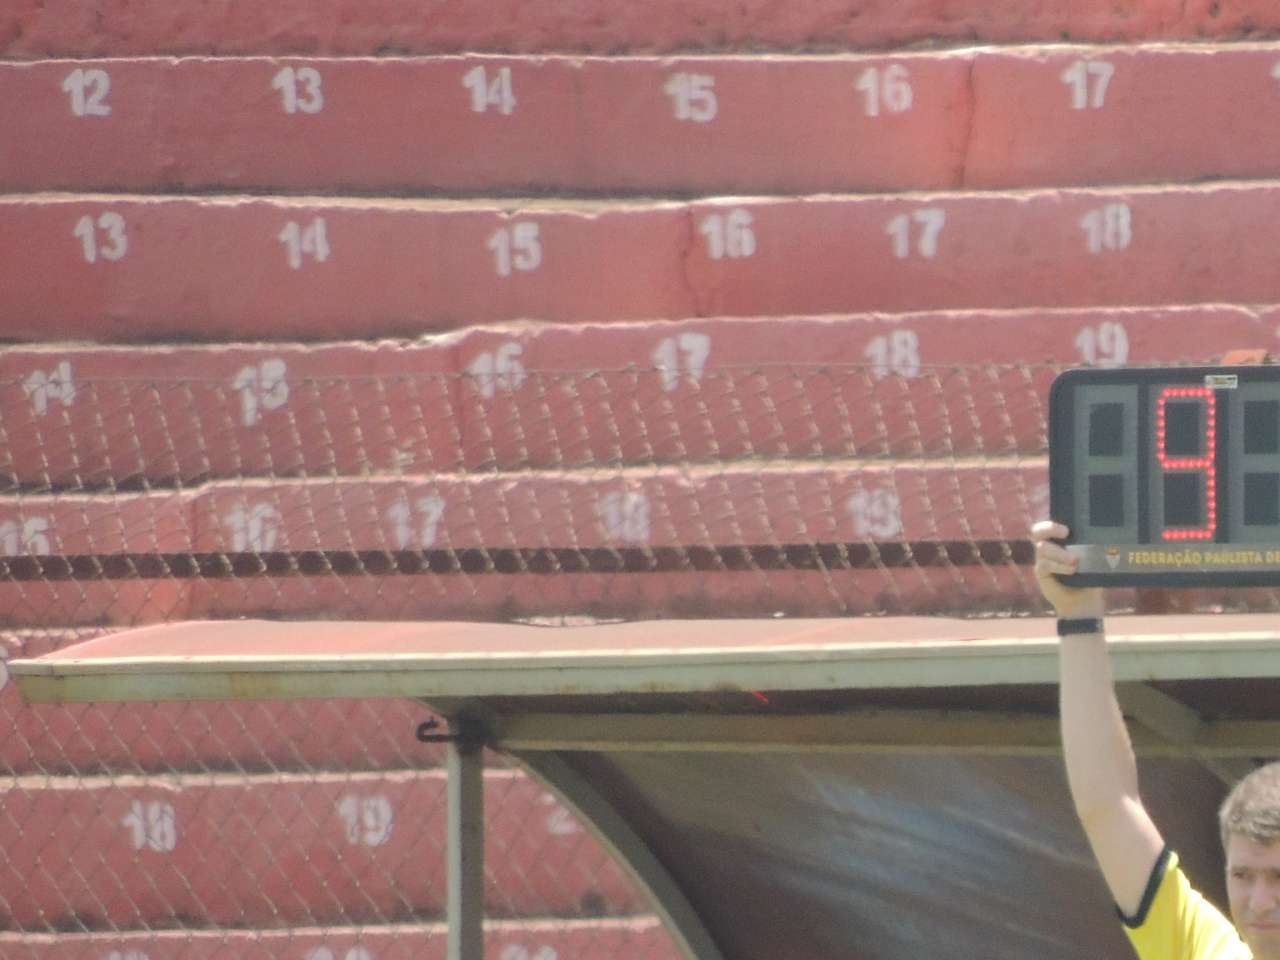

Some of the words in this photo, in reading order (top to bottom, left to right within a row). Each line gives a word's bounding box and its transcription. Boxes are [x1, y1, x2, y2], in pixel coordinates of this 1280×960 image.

[63, 68, 112, 117] 12
[272, 67, 324, 114] 13
[463, 66, 515, 114] 14
[666, 73, 718, 122] 15
[856, 64, 913, 117] 16
[1062, 61, 1115, 109] 17
[74, 212, 128, 263] 13
[279, 217, 330, 270] 14
[488, 222, 542, 276] 15
[699, 209, 756, 259] 16
[886, 208, 946, 258] 17
[1081, 204, 1133, 254] 18
[654, 332, 712, 392] 17
[865, 329, 921, 381] 18
[1074, 321, 1129, 368] 19
[23, 360, 75, 416] 14
[470, 342, 526, 399] 16
[1156, 386, 1216, 540] 9
[387, 497, 444, 548] 17
[1128, 549, 1201, 567] FEDERAÇÃO
[1205, 550, 1261, 564] PAULISTA
[337, 795, 393, 846] 19
